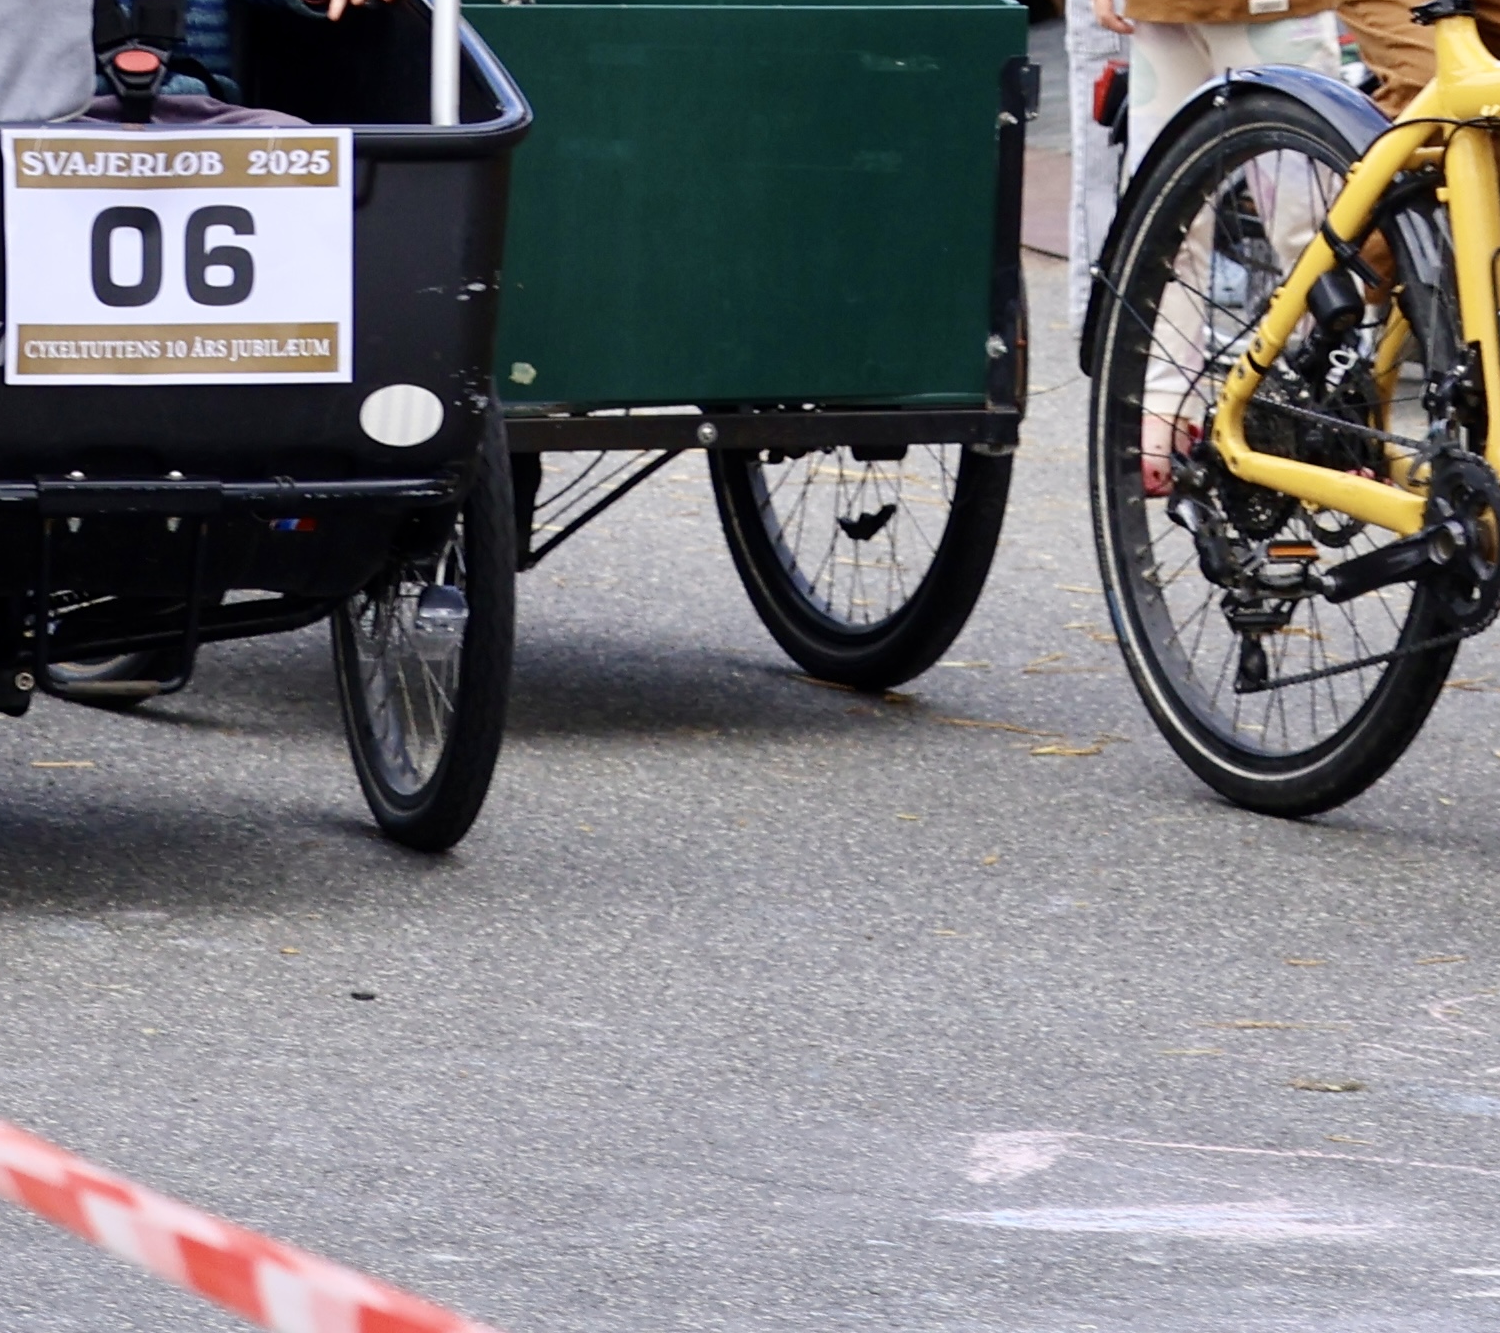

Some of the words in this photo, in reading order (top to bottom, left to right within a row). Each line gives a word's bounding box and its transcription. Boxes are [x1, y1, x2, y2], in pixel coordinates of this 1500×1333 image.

[20, 150, 224, 178] SVAJERLØB
[246, 149, 331, 176] 2025
[90, 204, 257, 308] 06
[23, 339, 161, 360] CYKELTUTTENS
[165, 341, 188, 358] 10
[190, 336, 227, 358] ÅRS
[230, 338, 330, 361] JUBILÆUM
